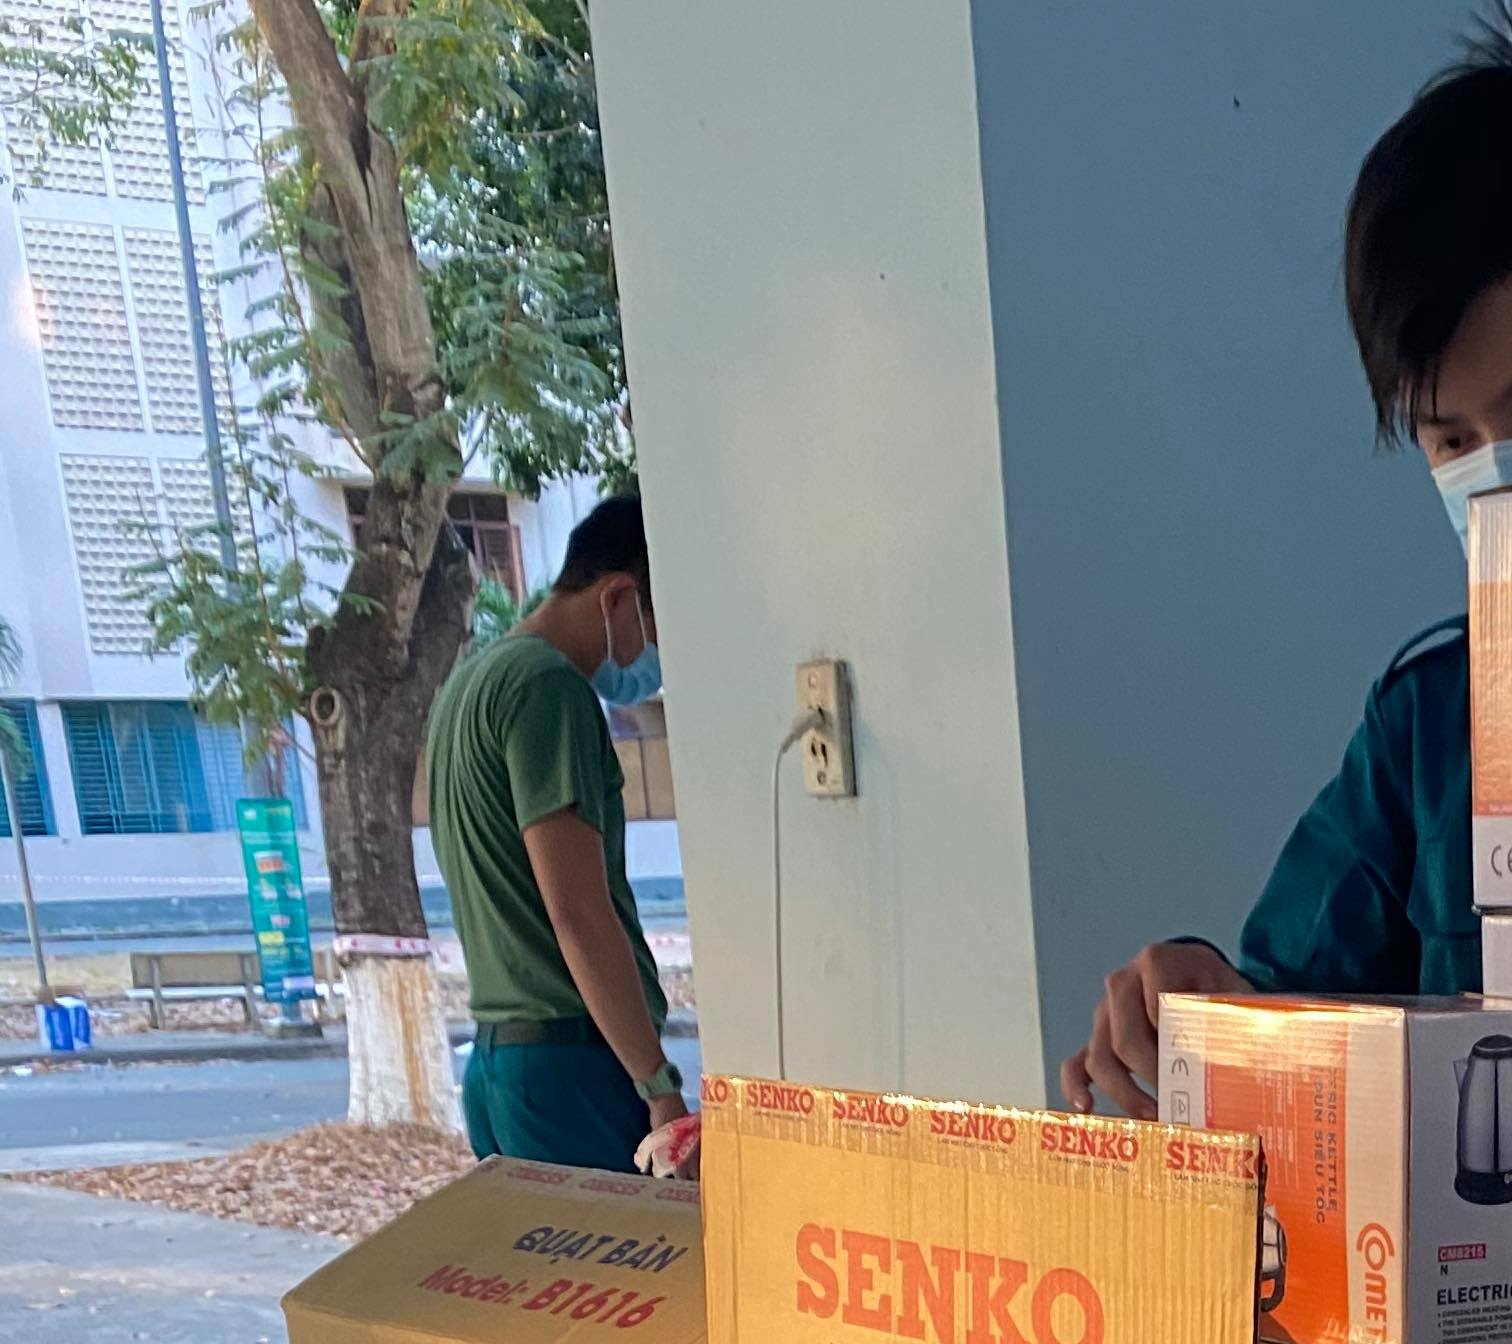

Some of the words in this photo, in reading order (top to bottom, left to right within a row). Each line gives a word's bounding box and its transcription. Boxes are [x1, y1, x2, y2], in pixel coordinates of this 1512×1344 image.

[746, 1082, 815, 1115] SENKO
[930, 1109, 1016, 1145] SENKO
[1040, 1123, 1138, 1162] SENKO
[513, 1226, 605, 1265] QUẠT
[605, 1233, 689, 1273] BÀN
[418, 1264, 528, 1304] Model:
[523, 1278, 668, 1328] B1616
[1356, 1223, 1395, 1343] COMET
